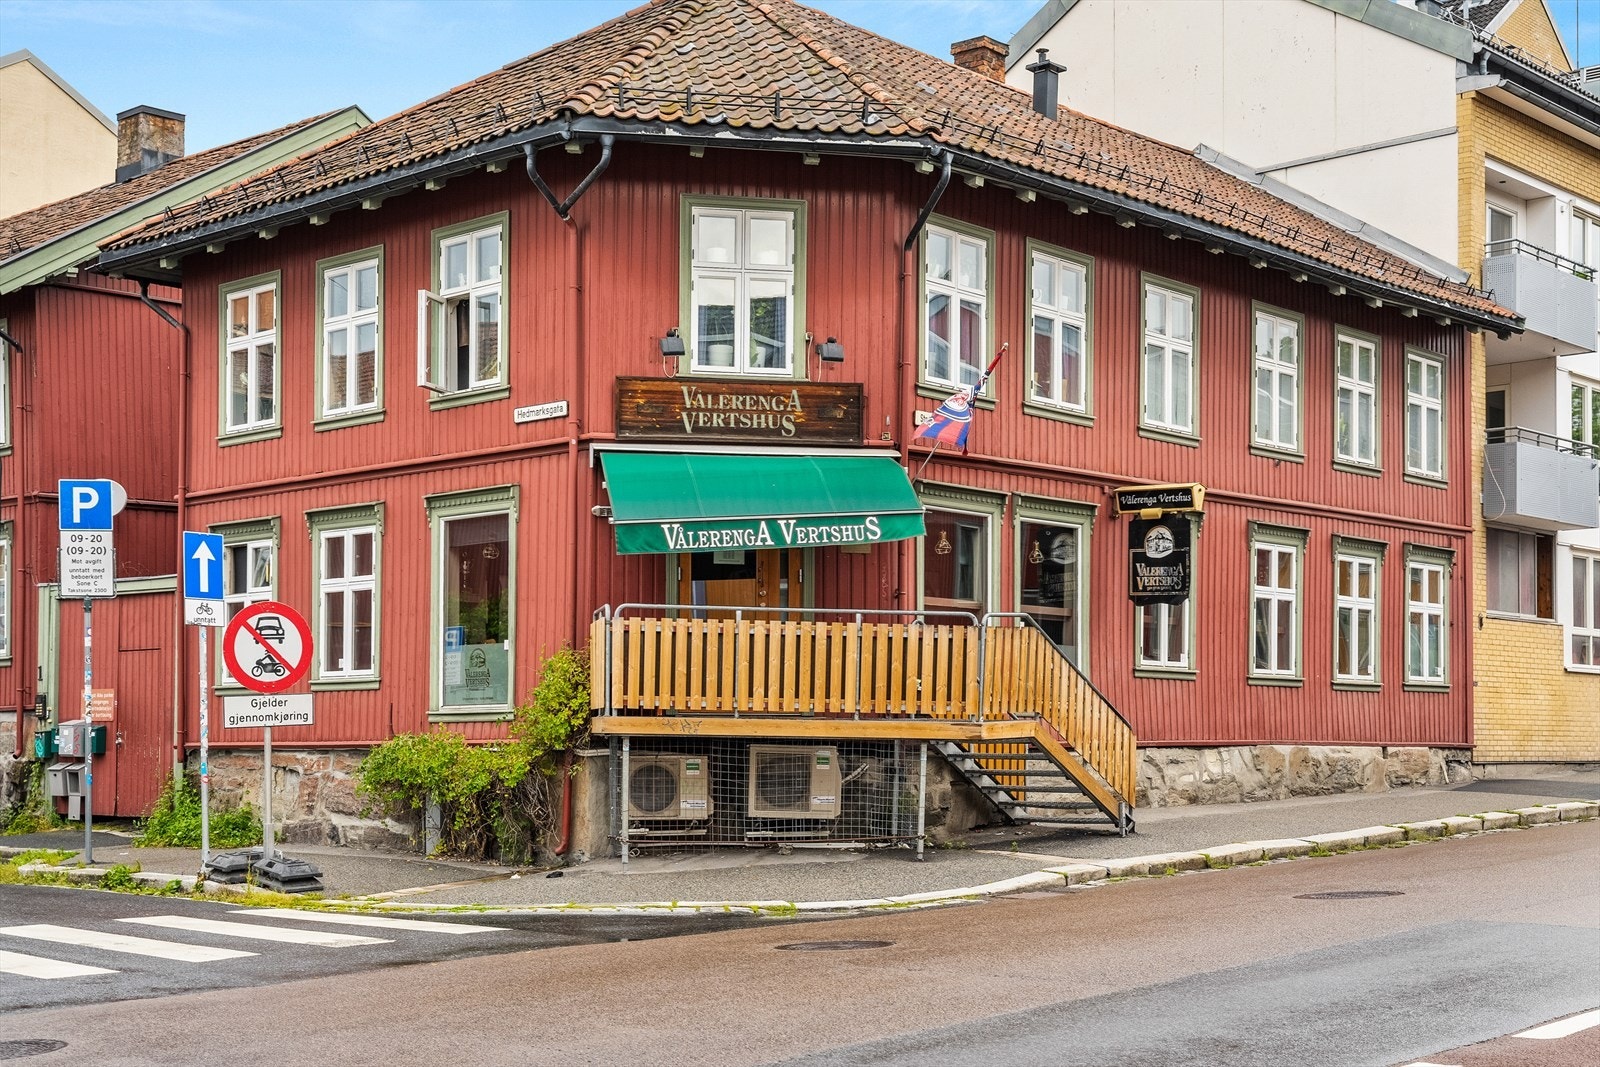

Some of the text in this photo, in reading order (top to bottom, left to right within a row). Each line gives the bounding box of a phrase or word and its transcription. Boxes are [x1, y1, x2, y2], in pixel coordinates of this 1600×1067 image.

[681, 385, 802, 411] VÅLERENGA
[517, 405, 563, 419] Hedmarksgata
[681, 411, 796, 437] VERTSHUS
[72, 487, 99, 523] P
[1121, 492, 1192, 506] Vålerenga Vertshus
[661, 516, 881, 550] VÅLERENGA VERTSHUS
[1136, 576, 1182, 591] VERTSHUS
[193, 616, 216, 624] unntatt
[251, 698, 288, 710] Gjelder
[229, 712, 309, 725] gjennomkjøring
